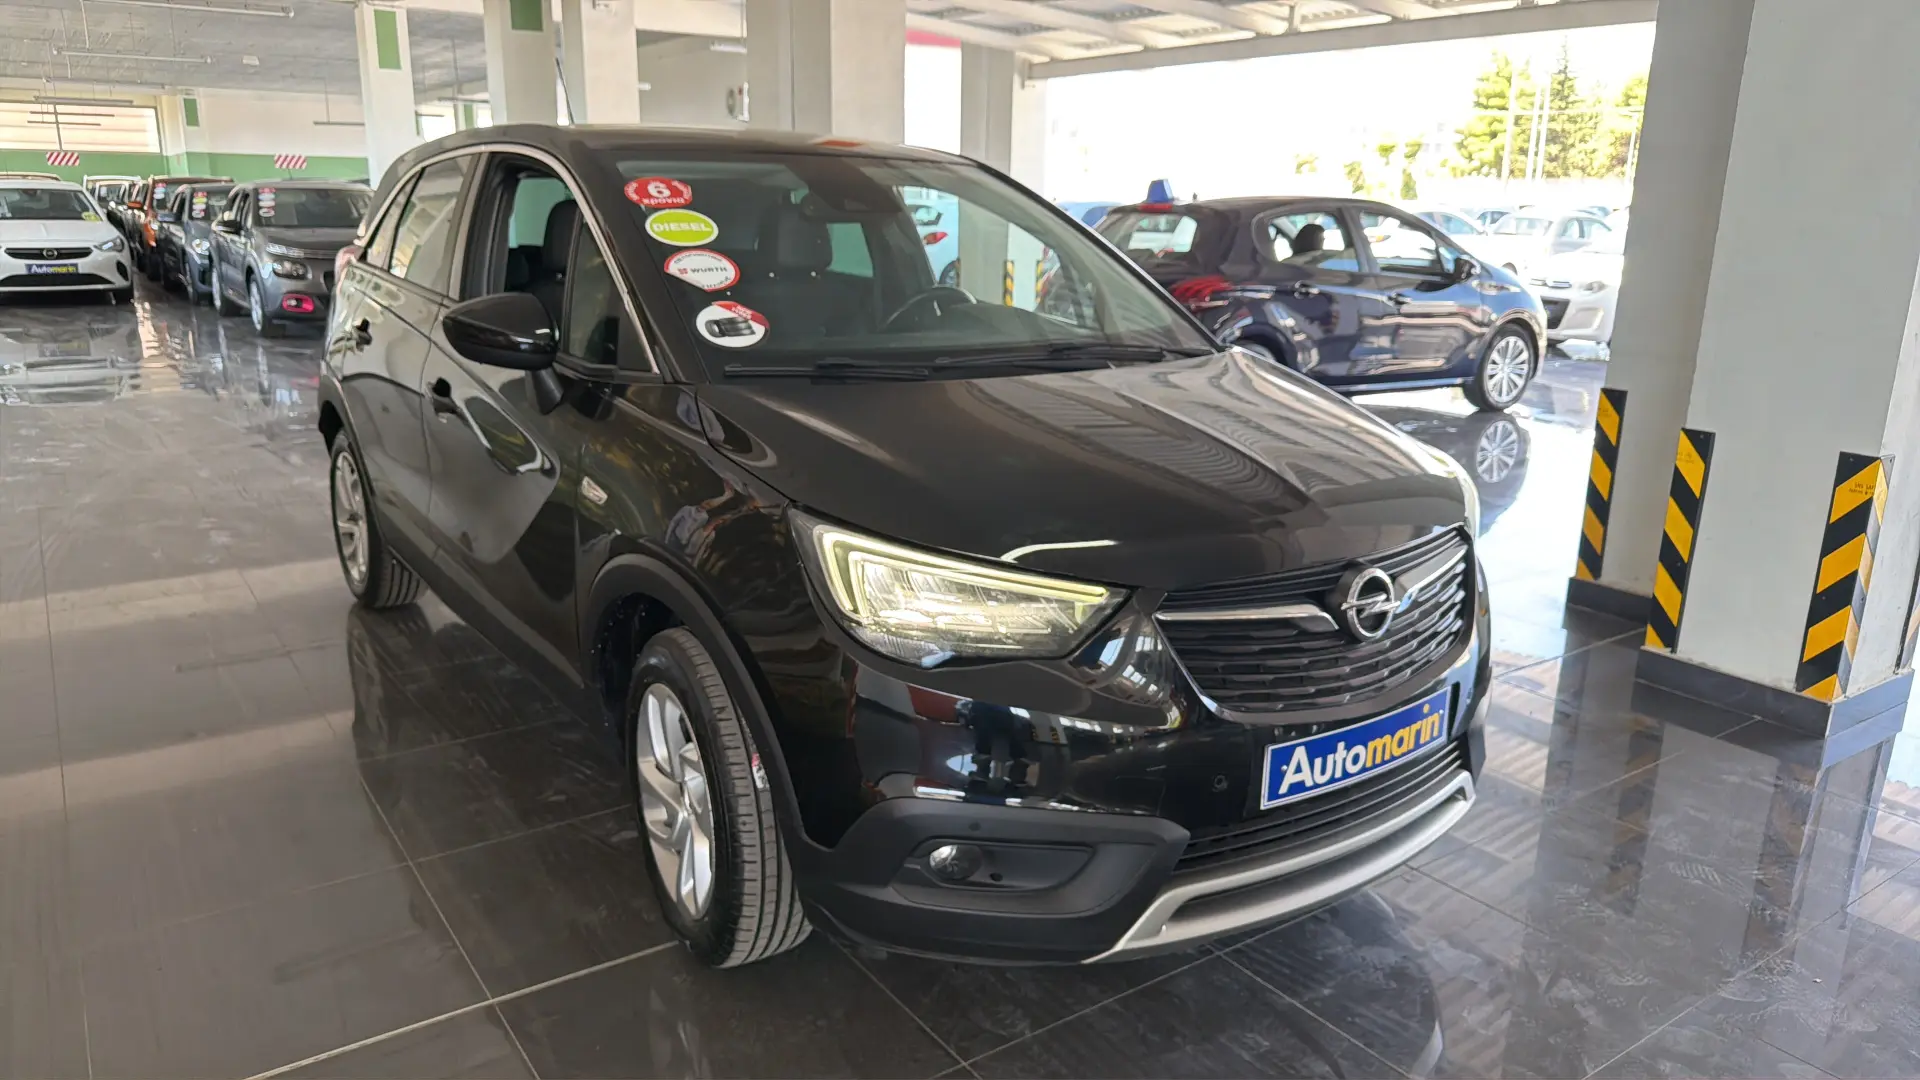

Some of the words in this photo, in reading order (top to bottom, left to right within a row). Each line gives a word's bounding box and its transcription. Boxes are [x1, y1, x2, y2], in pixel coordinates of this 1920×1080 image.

[647, 181, 672, 198] 6
[652, 222, 712, 232] DIESEL
[31, 265, 76, 274] Automarin
[1278, 703, 1440, 794] Automarin
